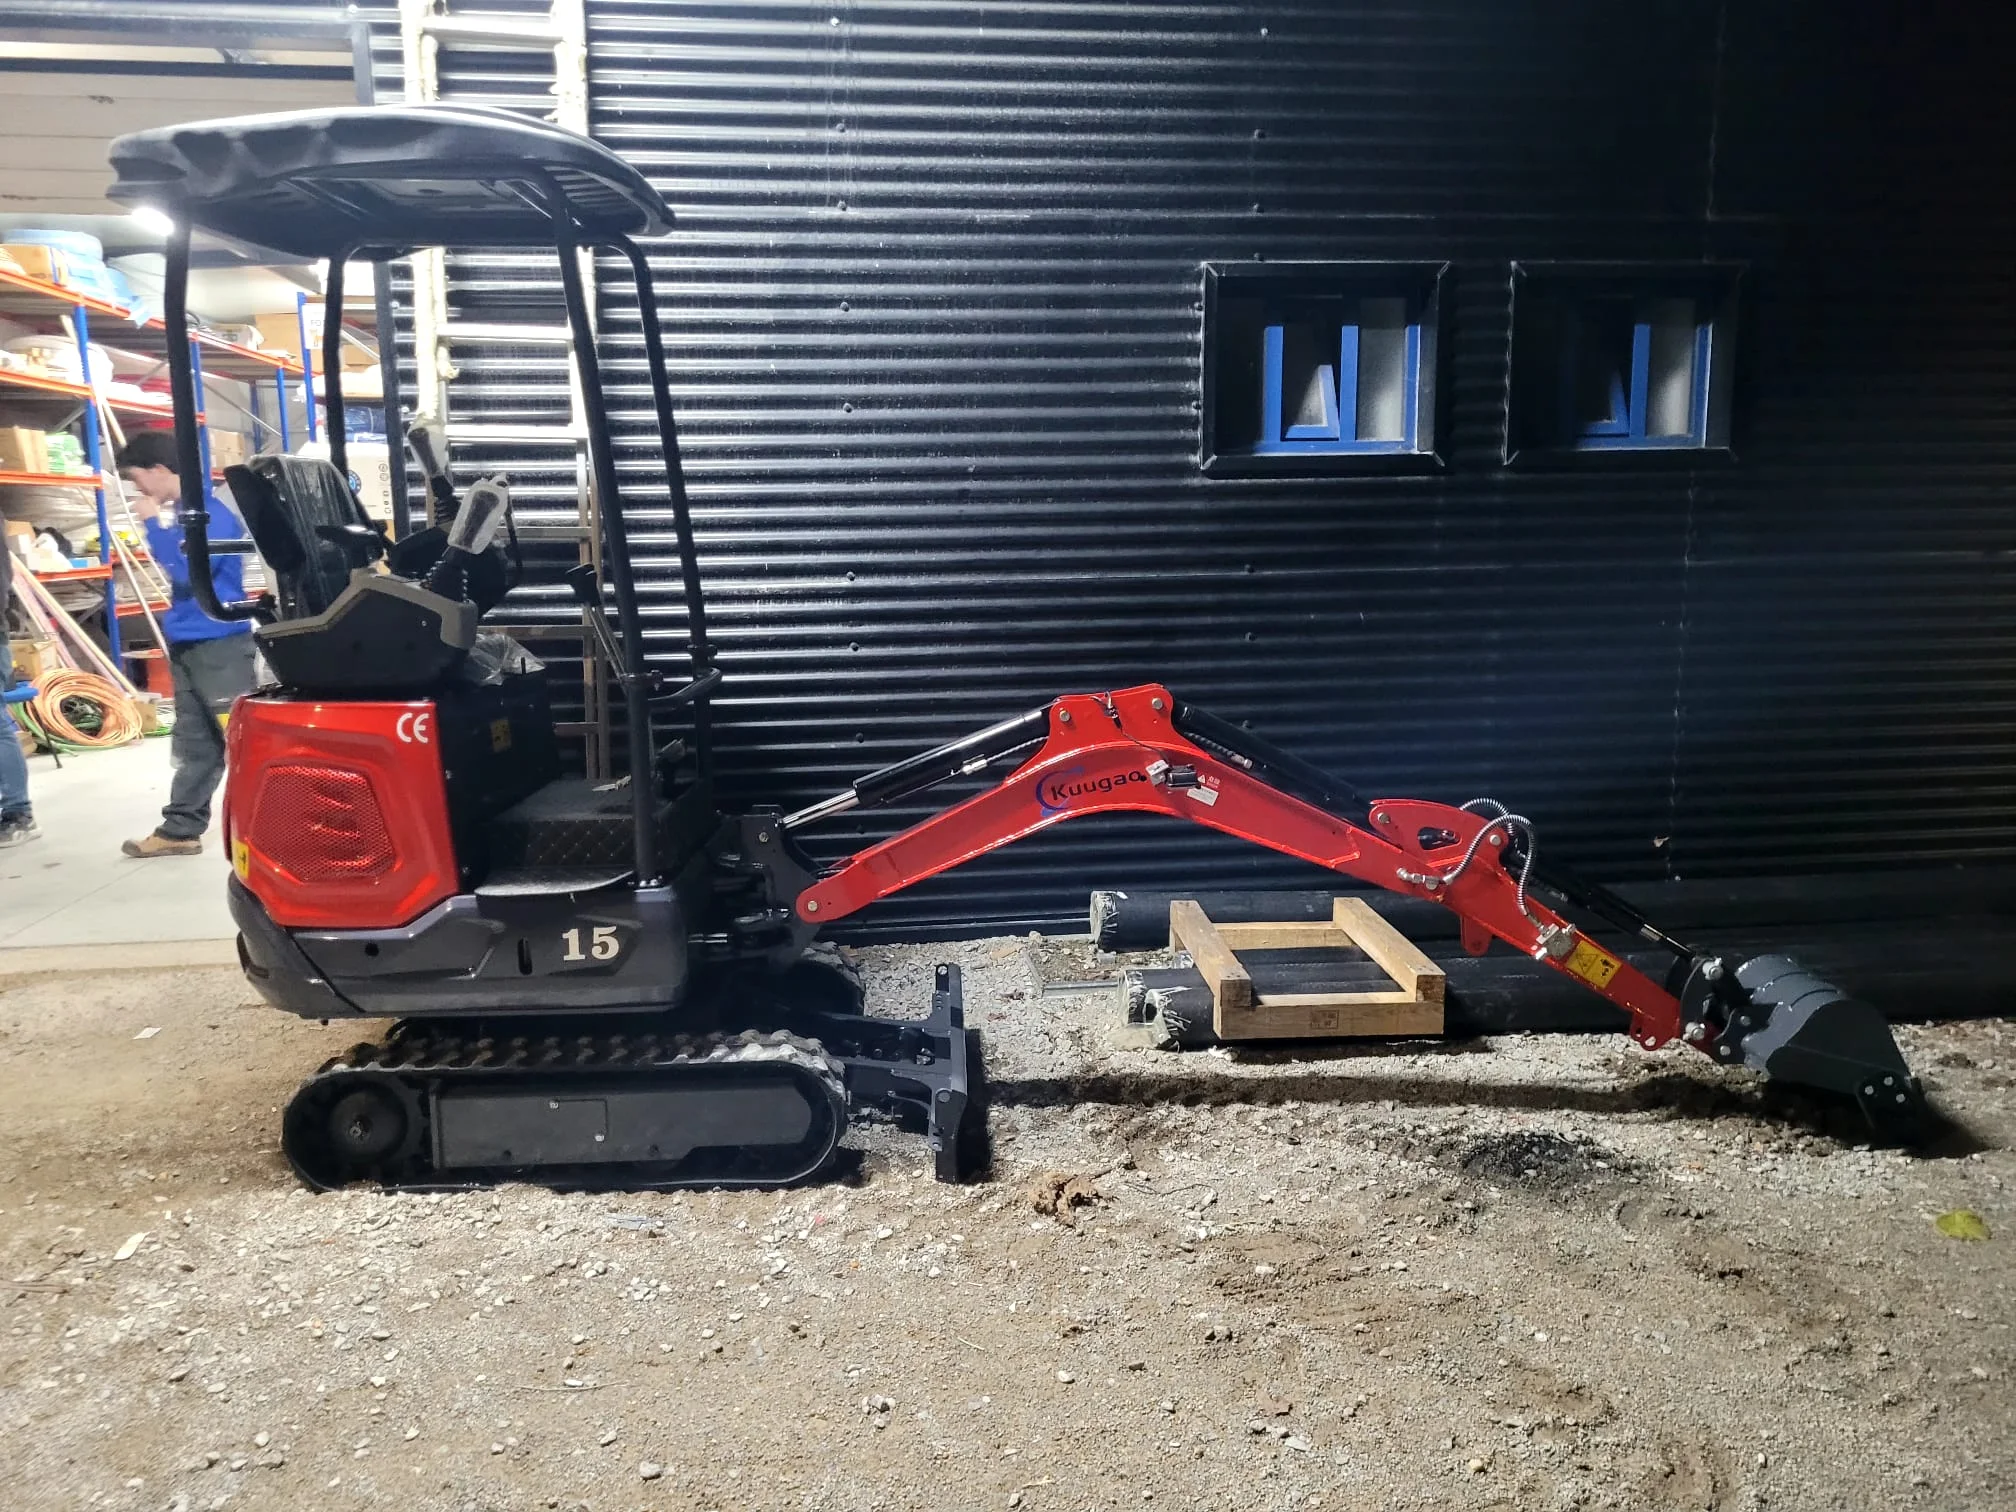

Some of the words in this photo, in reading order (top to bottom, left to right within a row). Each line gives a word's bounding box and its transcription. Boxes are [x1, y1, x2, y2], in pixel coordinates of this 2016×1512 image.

[397, 712, 429, 743] CE
[1051, 770, 1141, 800] Kuugao
[562, 926, 619, 961] 15
